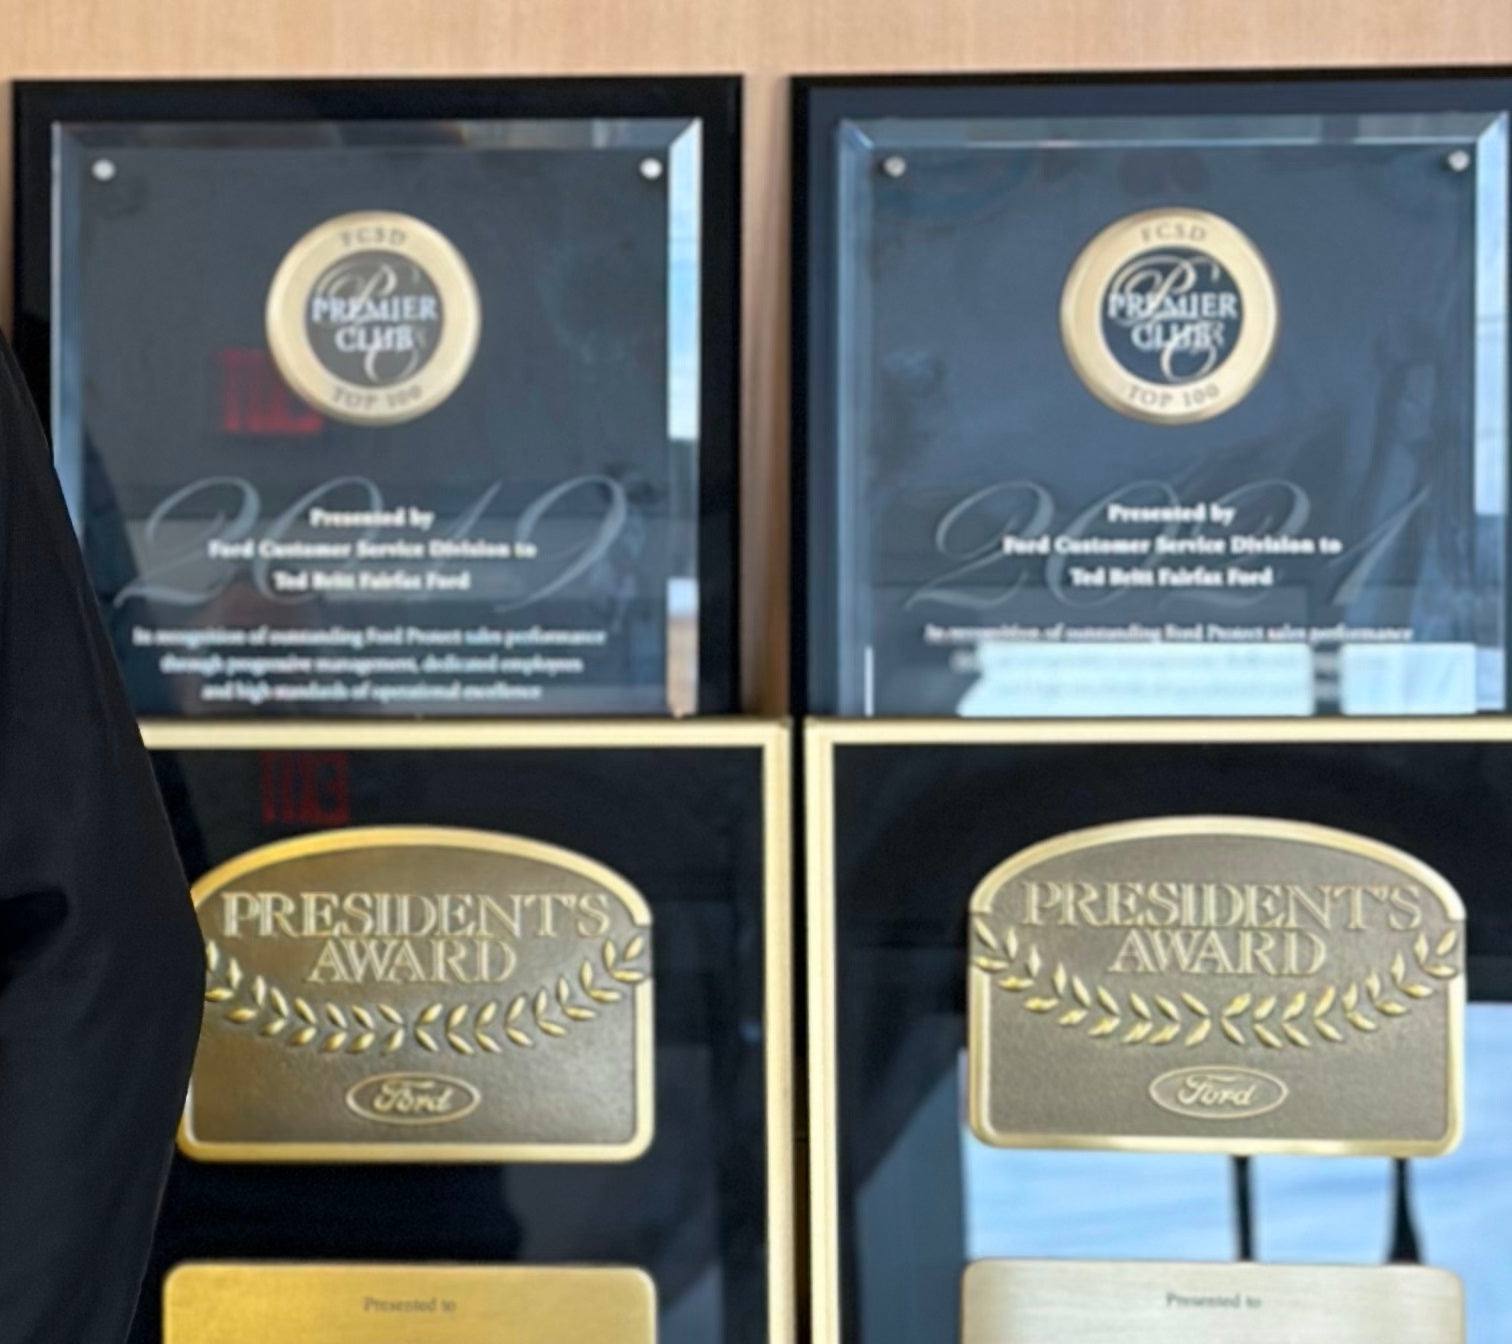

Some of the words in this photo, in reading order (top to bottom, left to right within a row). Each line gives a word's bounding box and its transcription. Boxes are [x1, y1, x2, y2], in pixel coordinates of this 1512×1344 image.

[1141, 221, 1207, 242] FCSD
[311, 295, 436, 322] PREMIER
[1107, 291, 1238, 320] PREMIER
[334, 324, 414, 352] CLUB
[333, 387, 378, 409] TOP
[1128, 384, 1173, 407] TOP
[1183, 383, 1220, 406] 100
[310, 507, 405, 526] Presented
[409, 506, 435, 532] by
[1107, 503, 1206, 522] Presented
[1210, 503, 1236, 527] by
[207, 538, 254, 558] Ford
[258, 538, 351, 558] Customer
[356, 538, 424, 558] Service
[429, 537, 510, 558] Division
[514, 540, 537, 558] to
[1001, 534, 1050, 555] Ford
[1053, 535, 1150, 555] Customer
[1154, 534, 1226, 554] Service
[1230, 534, 1315, 554] Division
[1319, 536, 1343, 554] to
[273, 570, 308, 590] Ted
[311, 570, 355, 590] Britt
[358, 570, 422, 590] Fairfax
[426, 570, 471, 590] Ford
[1069, 567, 1105, 587] Ted
[1109, 567, 1153, 587] Britt
[1157, 567, 1223, 587] Fairfax
[1227, 567, 1274, 587] Ford
[222, 891, 611, 938] PRESIDENT'S
[1020, 881, 1422, 931] PRESIDENT'S
[307, 938, 518, 985] AWARD
[1107, 928, 1328, 976] AWARD
[372, 1080, 453, 1114] Ford
[1176, 1074, 1258, 1107] Ford
[363, 1296, 436, 1312] Presented
[440, 1299, 456, 1312] to
[1166, 1291, 1241, 1308] Presented
[1245, 1295, 1262, 1308] to
